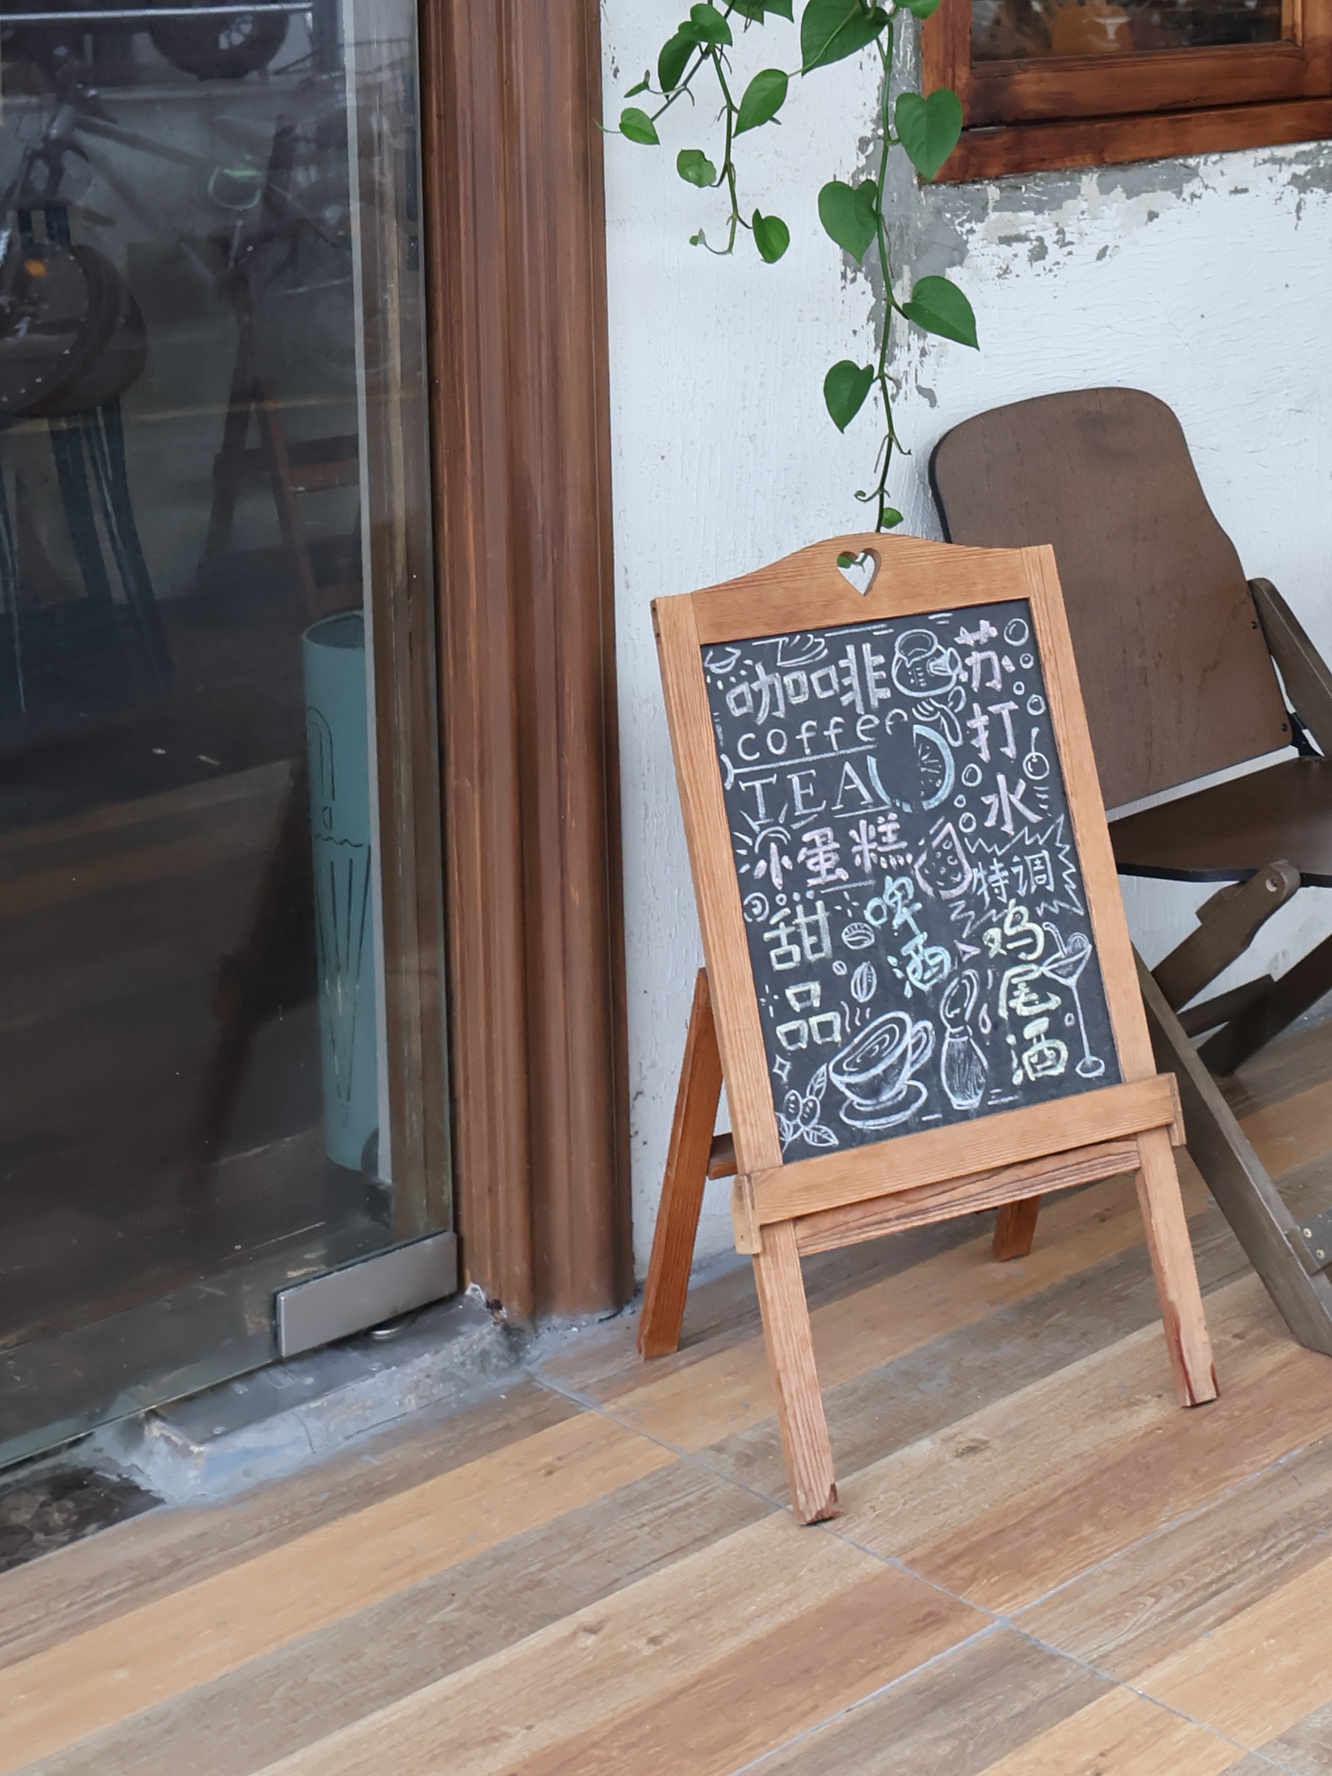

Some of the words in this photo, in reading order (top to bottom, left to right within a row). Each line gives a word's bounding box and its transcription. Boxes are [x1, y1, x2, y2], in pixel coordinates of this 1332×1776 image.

[725, 642, 891, 725] 咖啡
[954, 619, 1043, 836] 苏打水
[738, 761, 876, 826] TEA
[753, 812, 914, 891] 小蛋糕
[971, 849, 1055, 910] 特调
[763, 899, 842, 1051] 甜品
[863, 874, 951, 999] 啤酒
[983, 898, 1069, 1086] 鸡尾酒
